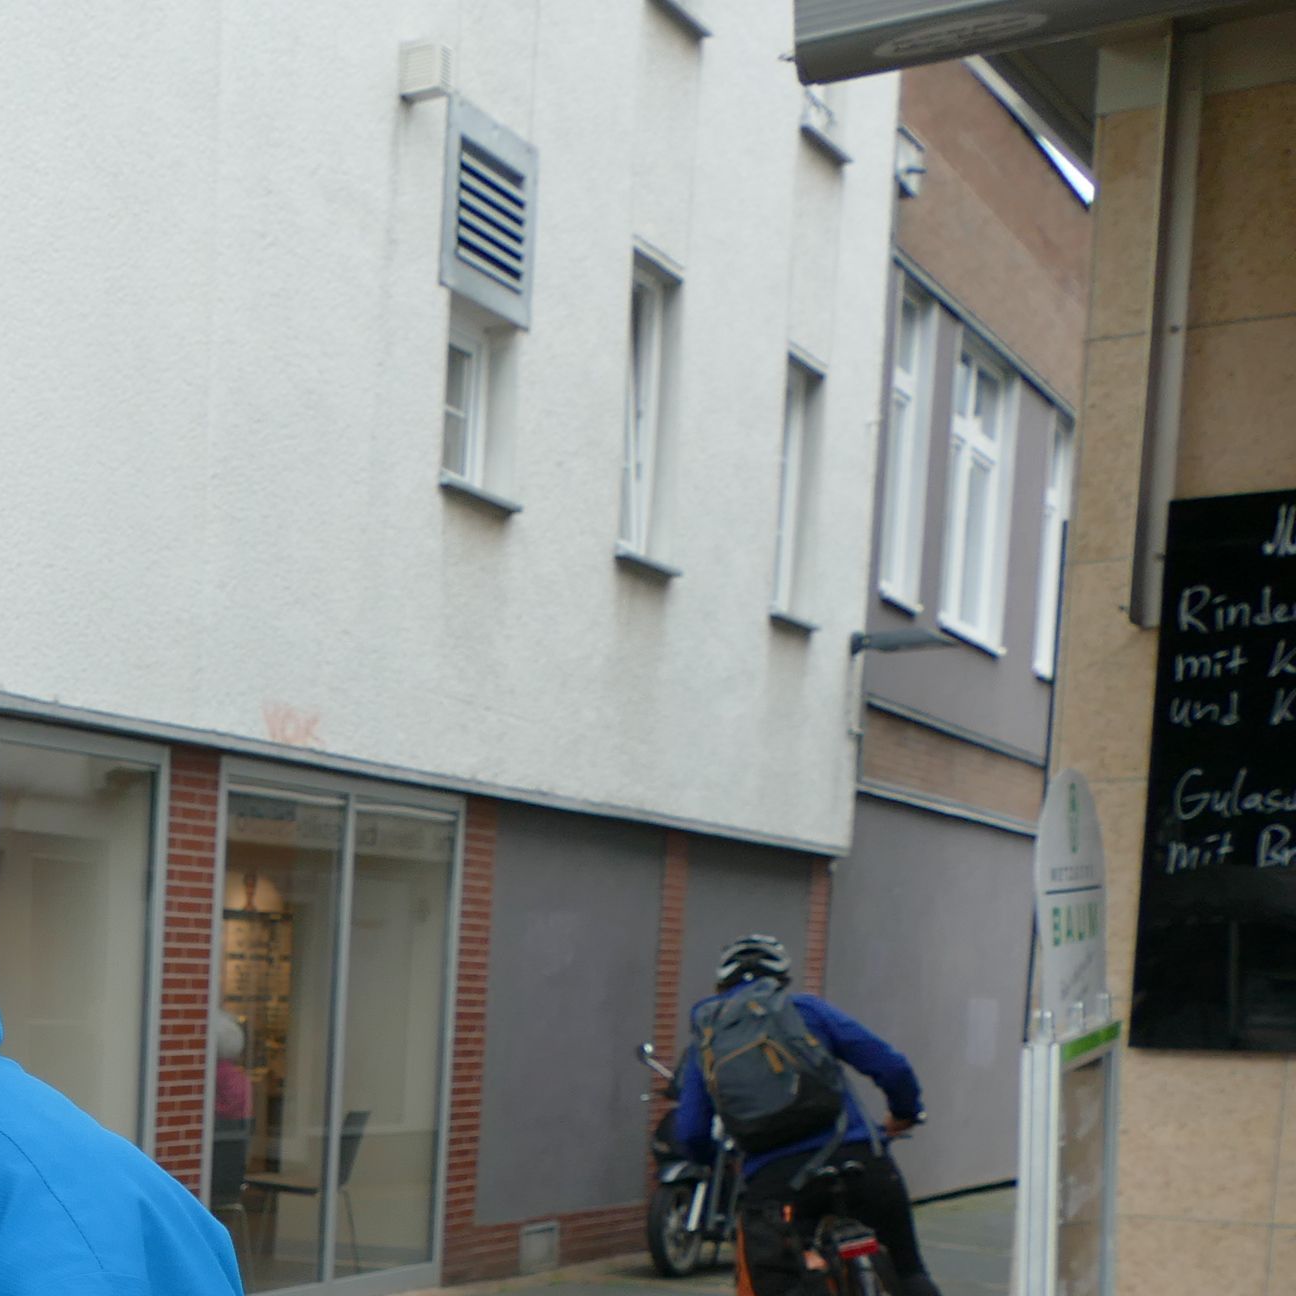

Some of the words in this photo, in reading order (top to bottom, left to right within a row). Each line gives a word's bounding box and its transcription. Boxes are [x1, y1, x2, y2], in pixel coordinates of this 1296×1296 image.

[1177, 585, 1296, 634] Rinde
[1175, 650, 1249, 681] mit
[1170, 690, 1240, 727] und
[1164, 832, 1235, 874] mit
